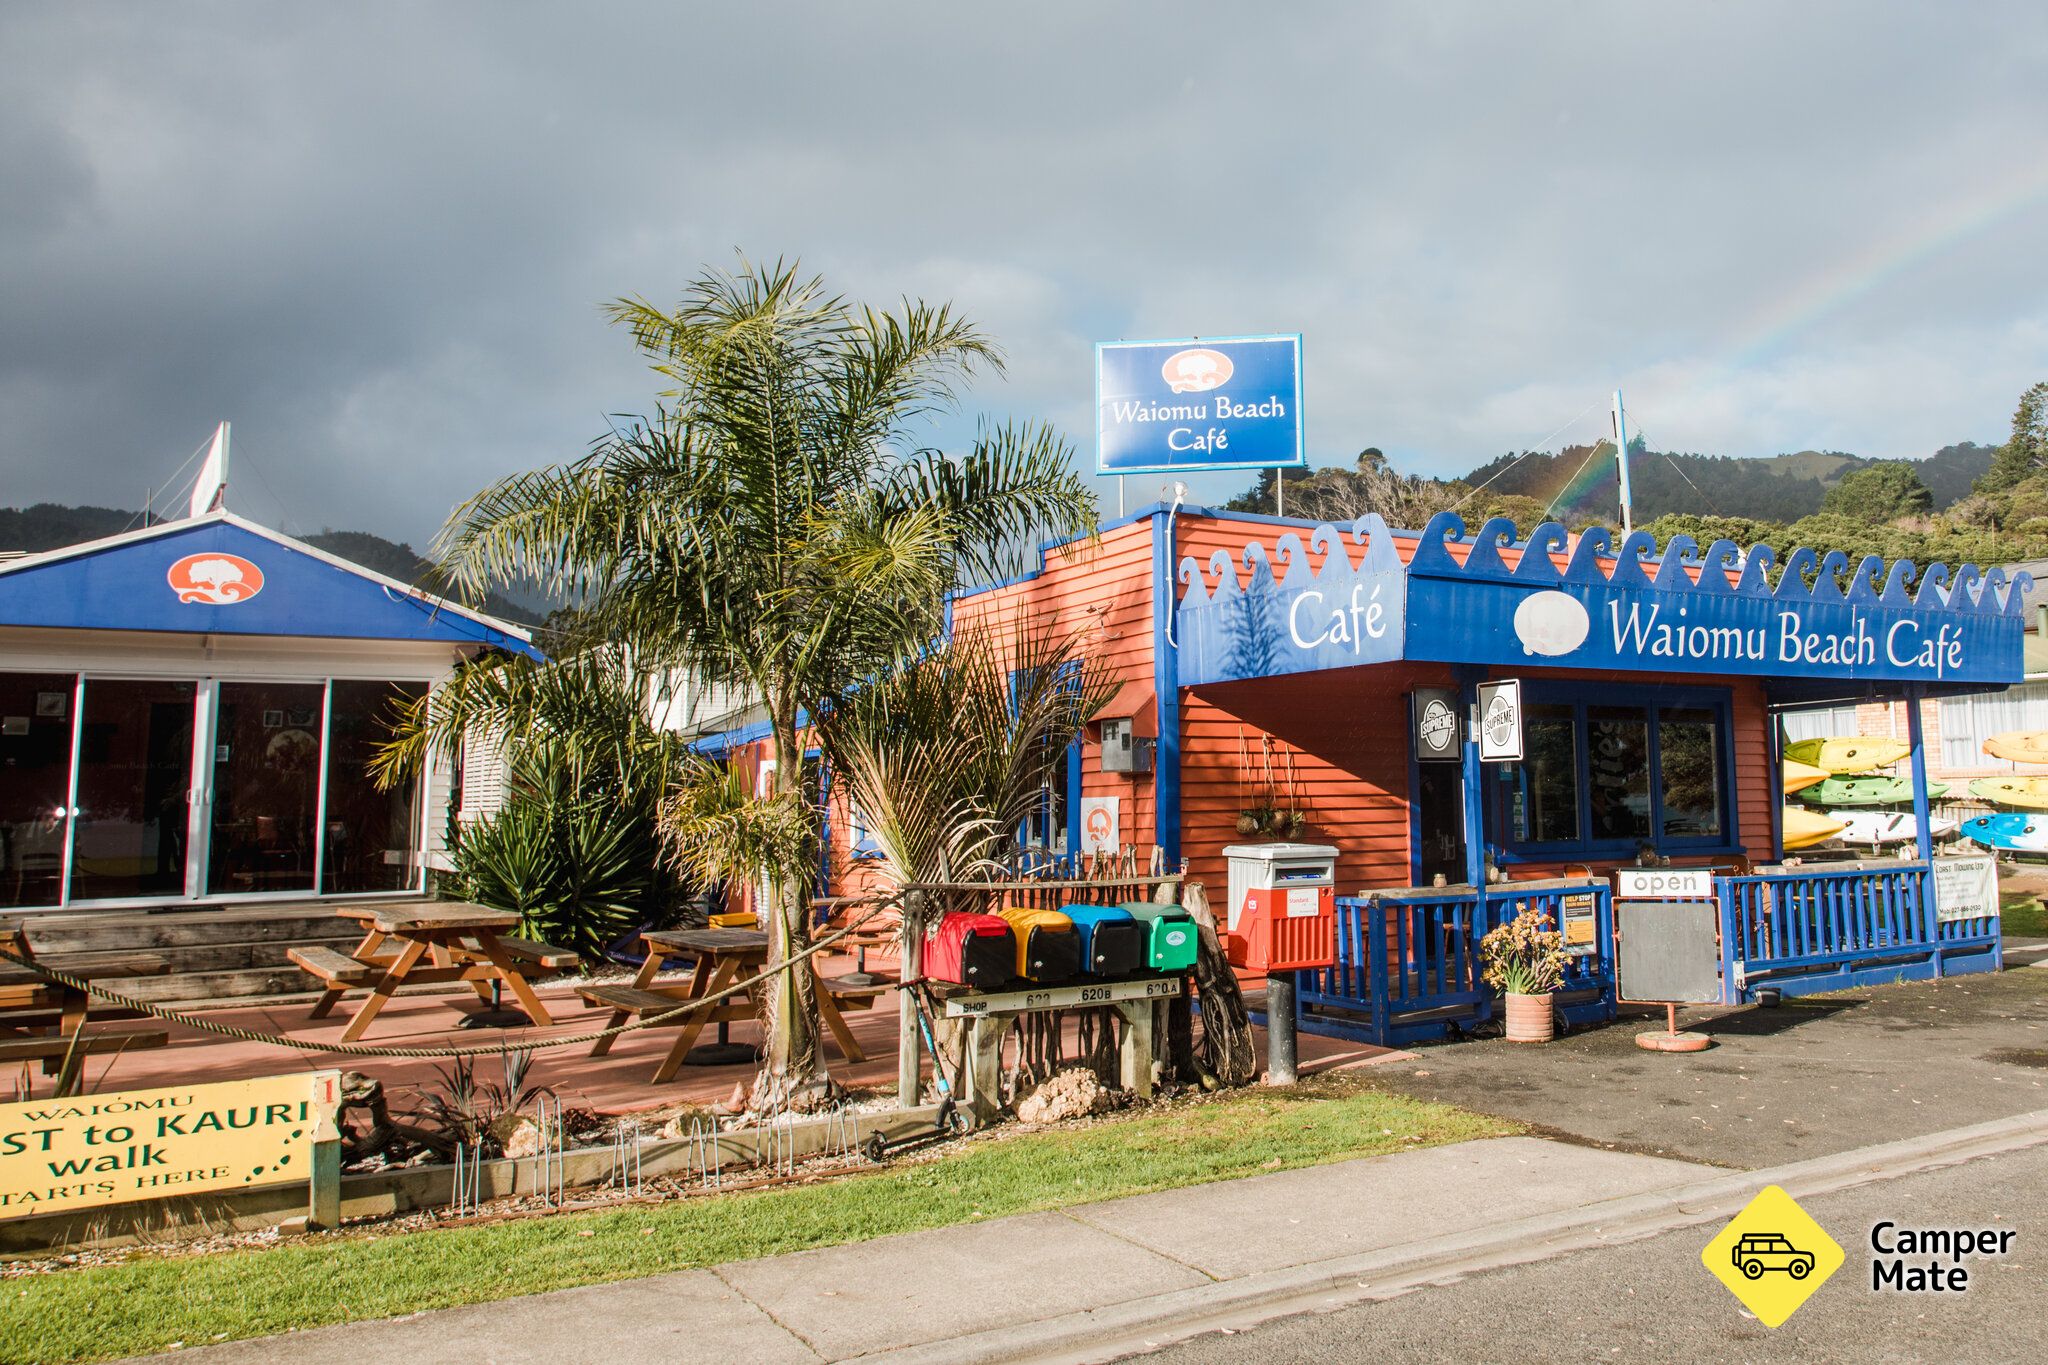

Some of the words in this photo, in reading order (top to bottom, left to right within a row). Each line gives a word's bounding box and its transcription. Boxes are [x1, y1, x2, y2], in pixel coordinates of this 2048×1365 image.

[1112, 400, 1206, 424] Waiomu
[1215, 395, 1285, 419] Beach
[1168, 428, 1228, 455] Café
[1290, 584, 1386, 655] Café
[1608, 599, 1766, 661] Waiomu
[1778, 611, 1875, 665] Beach
[1887, 620, 1963, 679] Café
[1422, 714, 1453, 735] SUPREME
[1486, 709, 1513, 731] SUPREME
[1634, 876, 1697, 895] open
[963, 1001, 987, 1012] SHOP
[1082, 988, 1111, 1001] 620B
[22, 1095, 195, 1122] WAIOMU
[1, 1127, 63, 1156] ST
[84, 1124, 134, 1145] to
[157, 1101, 309, 1138] KAURI
[48, 1144, 169, 1178] walk
[135, 1165, 231, 1188] HERE
